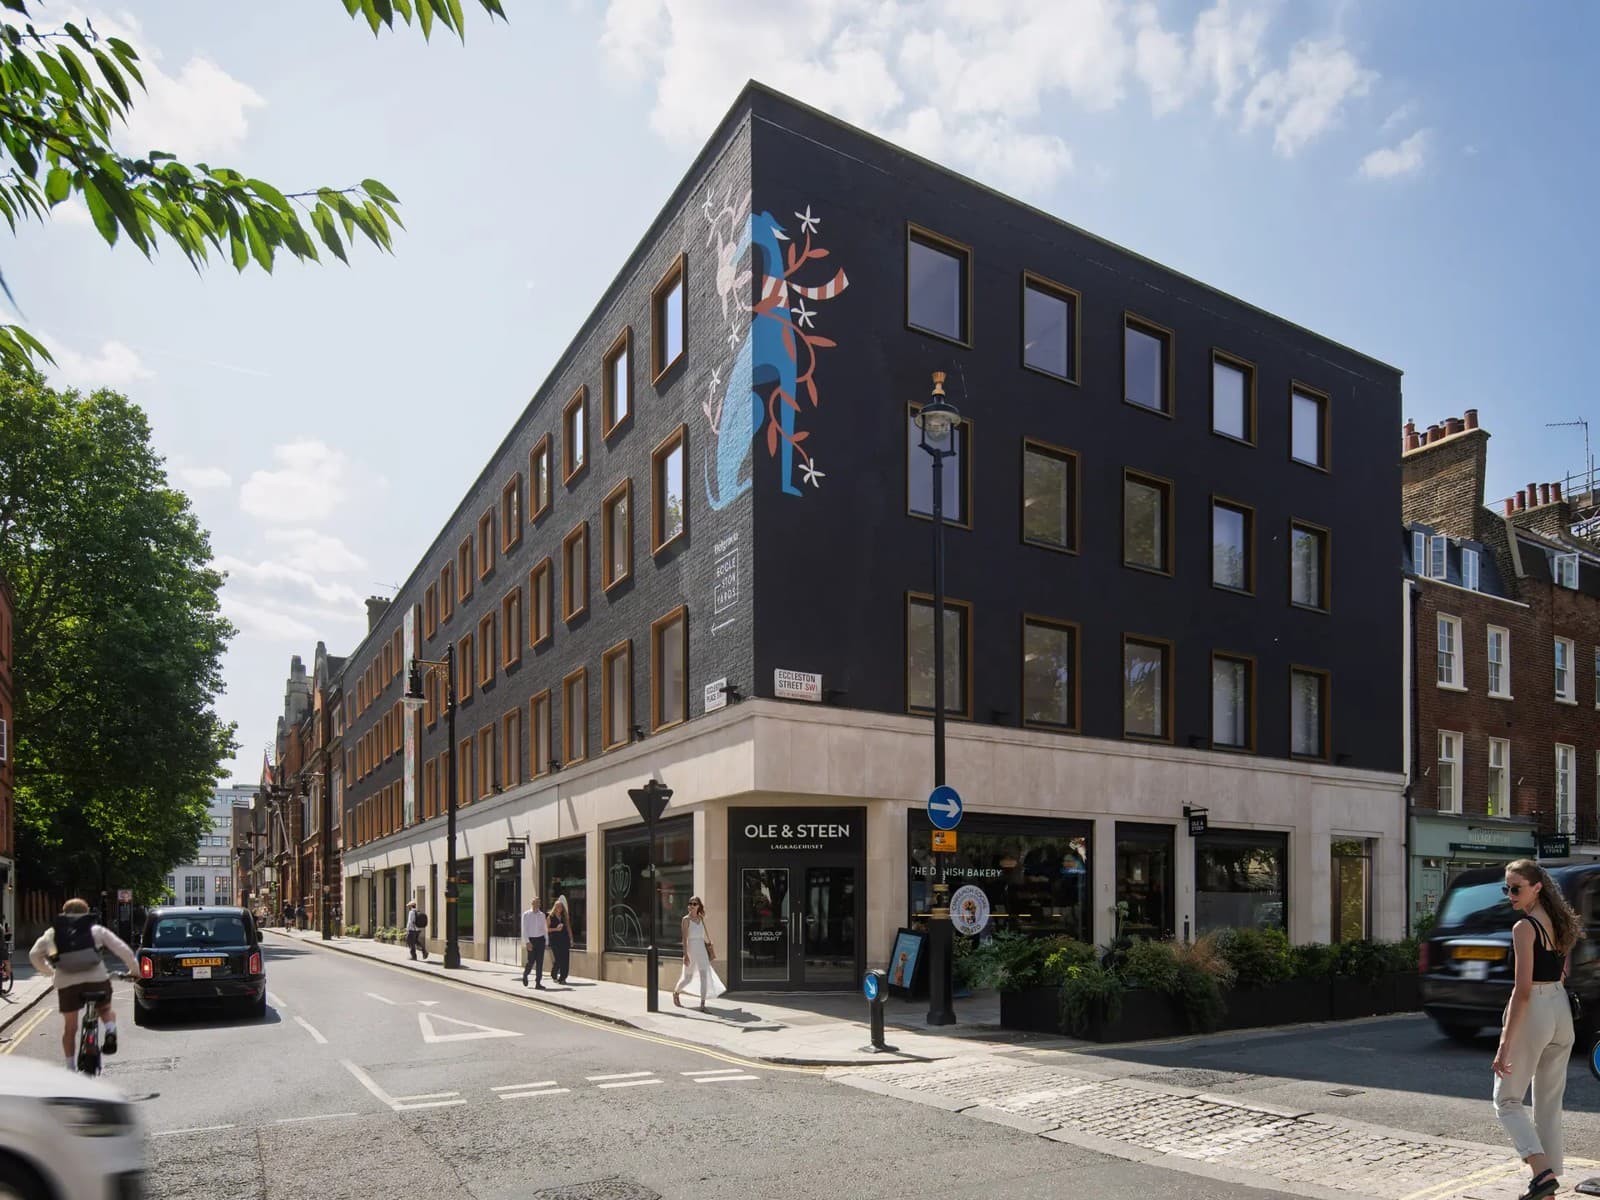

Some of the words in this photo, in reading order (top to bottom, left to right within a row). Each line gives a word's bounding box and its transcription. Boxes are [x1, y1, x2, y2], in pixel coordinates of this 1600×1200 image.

[778, 670, 816, 683] ECCLESTON
[778, 680, 803, 690] STREET
[744, 824, 778, 838] OLE
[781, 824, 794, 838] &
[796, 824, 850, 838] STEEN
[930, 866, 965, 877] DNISH
[967, 868, 1003, 878] BAKERY
